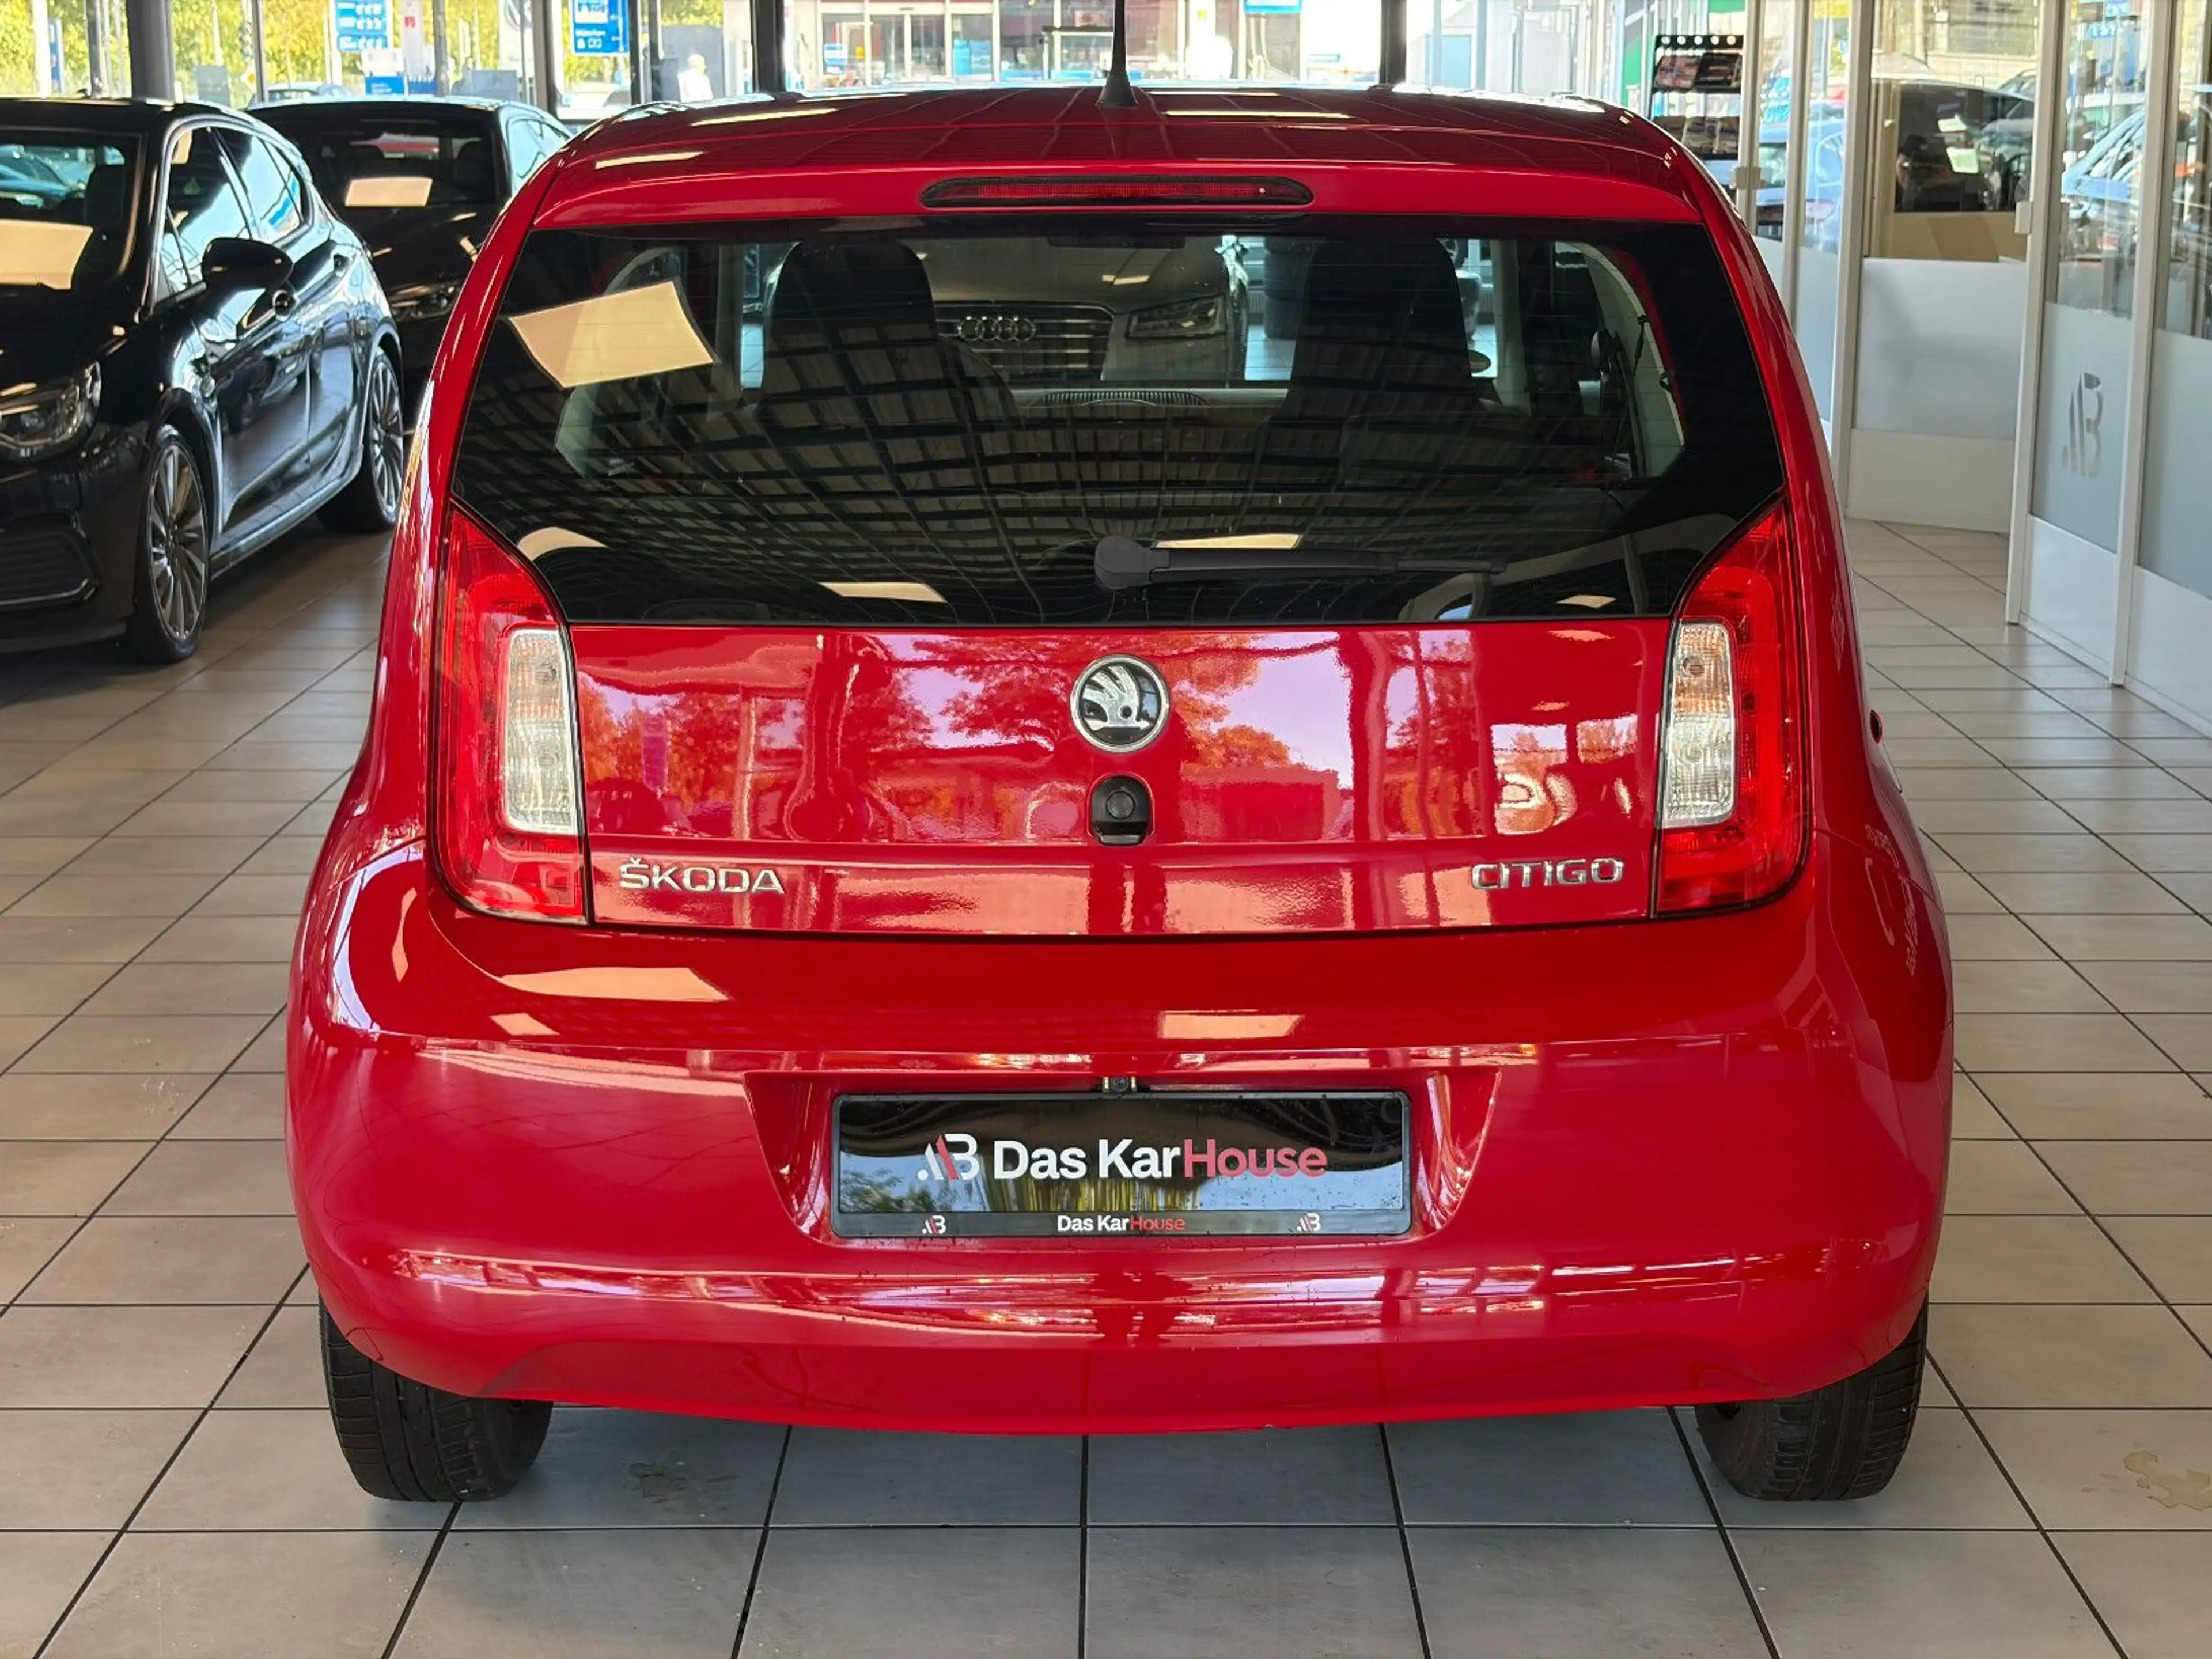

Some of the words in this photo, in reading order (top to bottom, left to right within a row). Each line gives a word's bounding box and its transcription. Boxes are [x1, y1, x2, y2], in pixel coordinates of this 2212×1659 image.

[619, 857, 785, 894] ŠKODA
[1472, 857, 1624, 889] CITIGO
[994, 1140, 1086, 1179] Das
[1099, 1139, 1328, 1179] KarHouse
[1058, 1214, 1094, 1232] Das
[1097, 1214, 1186, 1231] KarHouse
